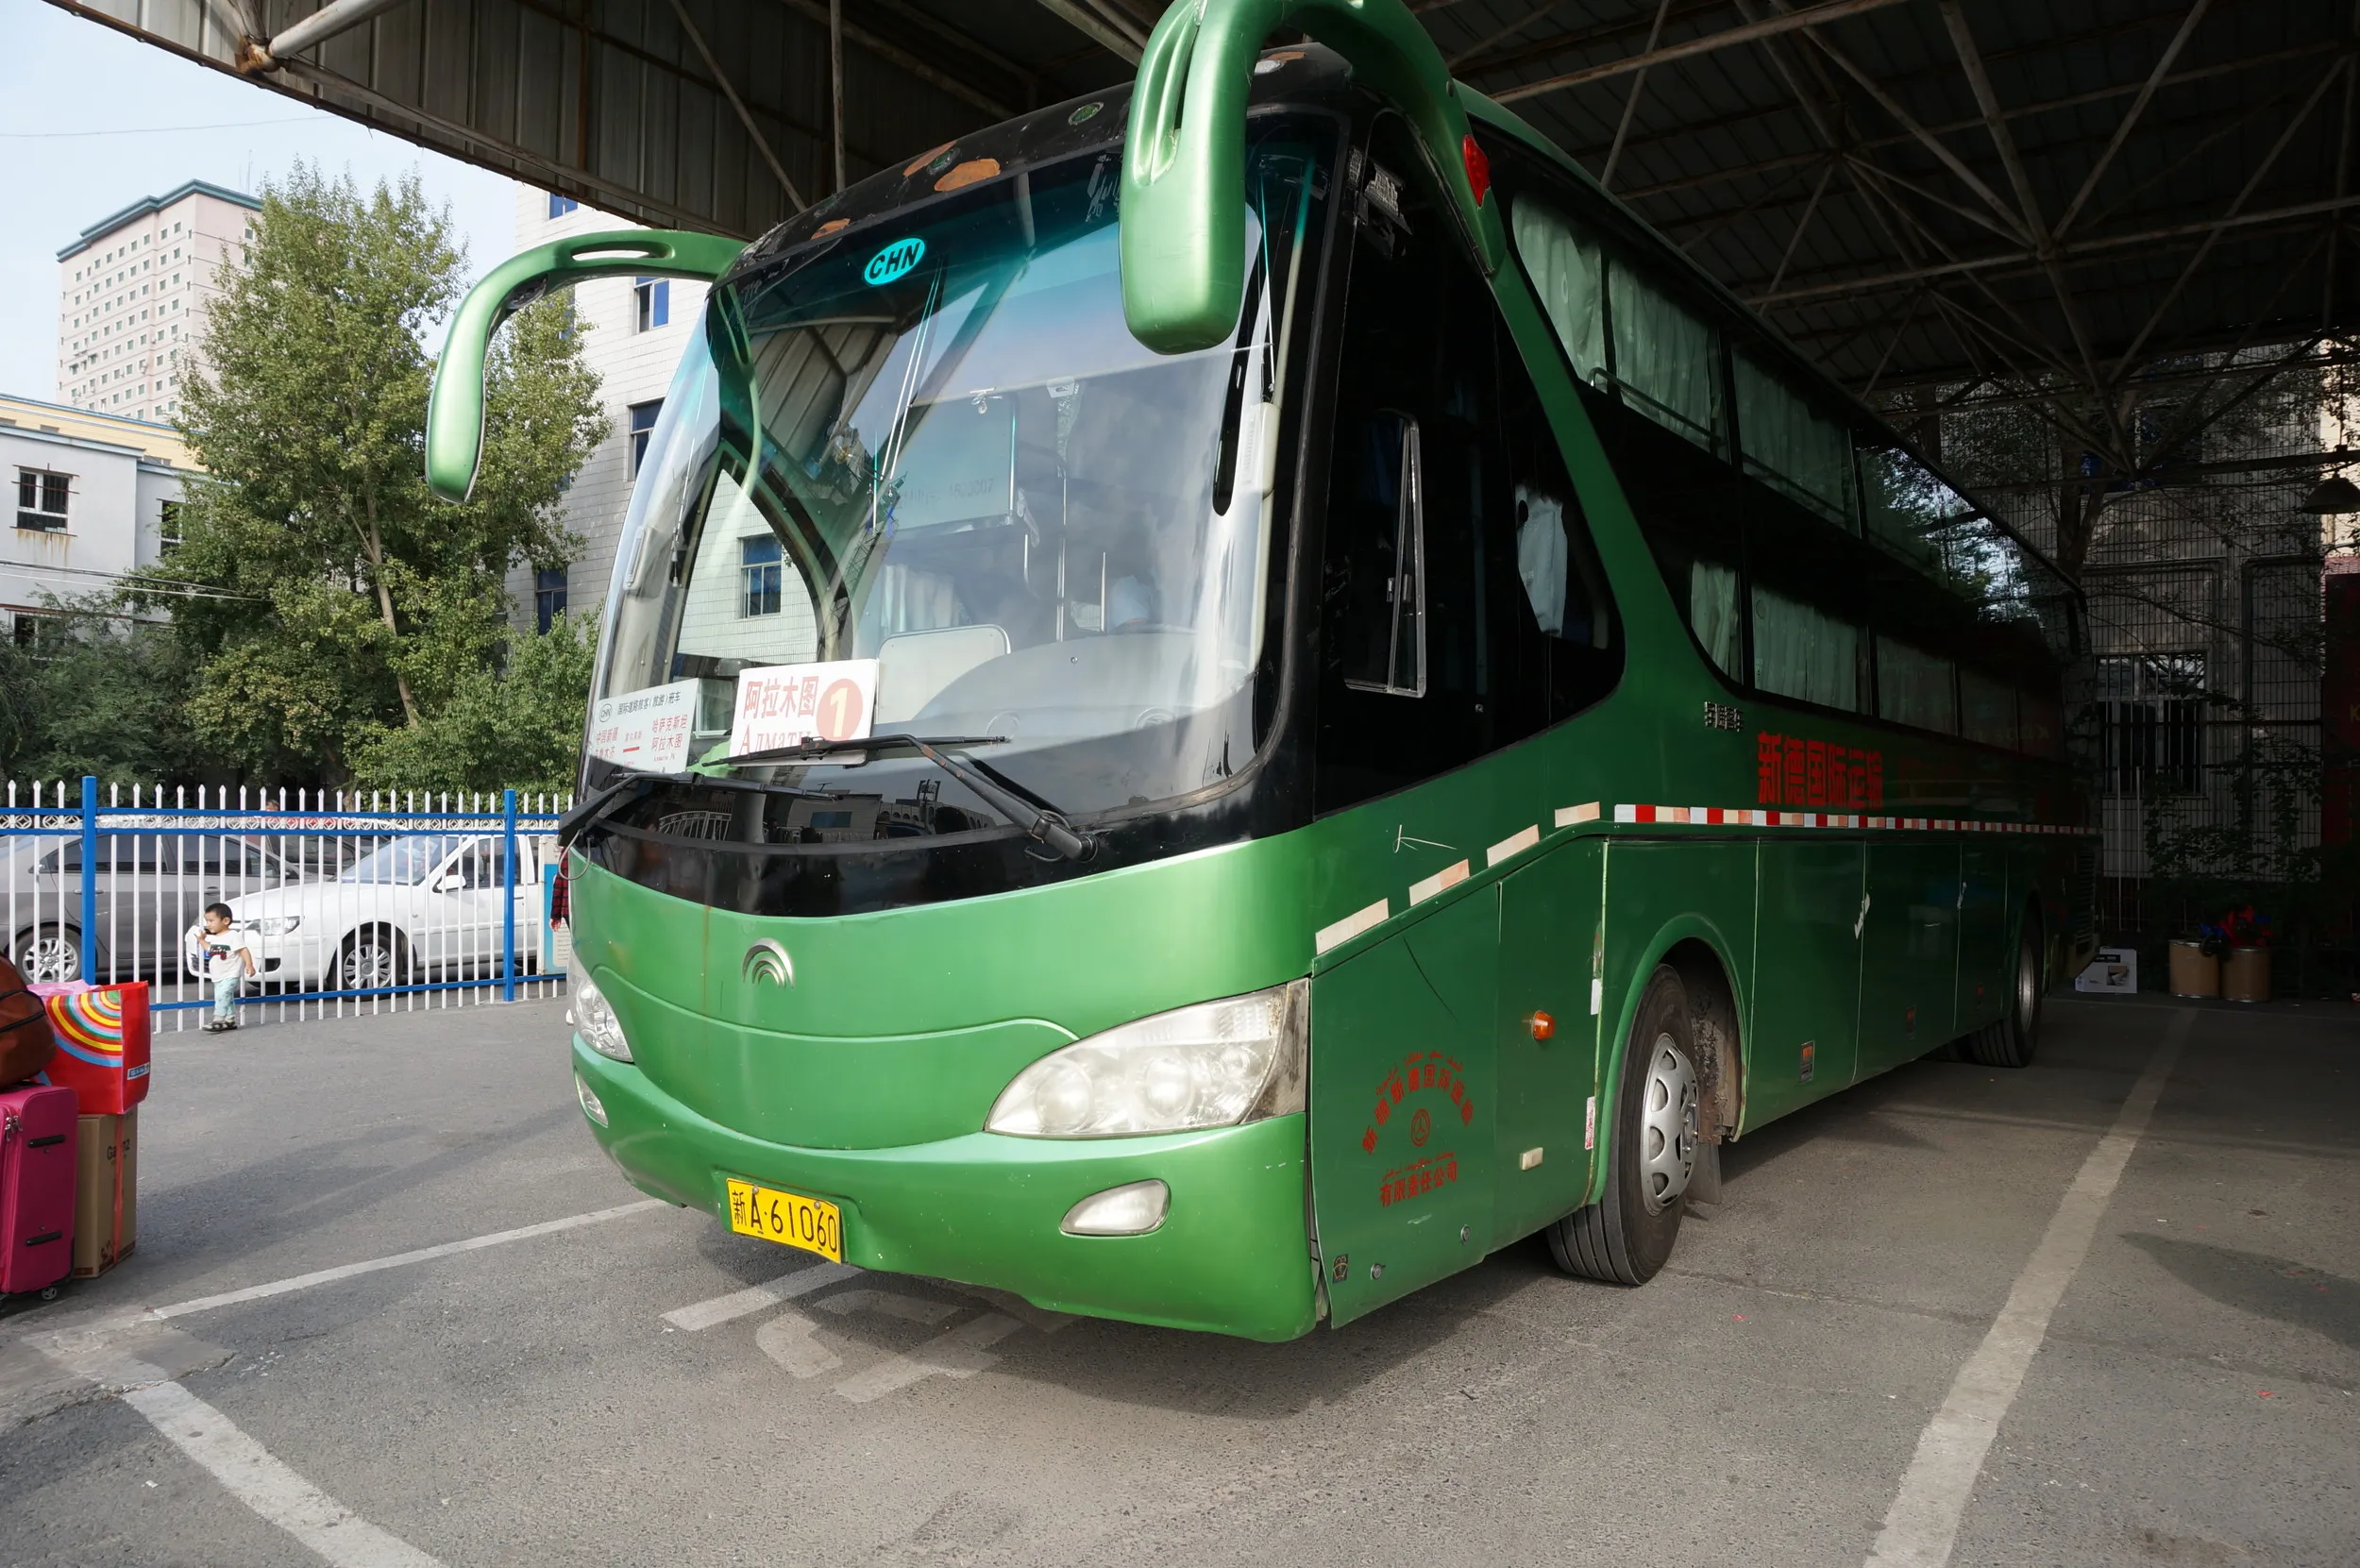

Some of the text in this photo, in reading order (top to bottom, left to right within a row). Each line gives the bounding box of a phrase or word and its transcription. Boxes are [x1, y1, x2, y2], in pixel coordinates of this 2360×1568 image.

[869, 242, 920, 279] CHN
[743, 676, 819, 719] 阿拉木图
[830, 686, 849, 738] 1
[651, 714, 687, 733] 哈萨克斯坦
[651, 733, 683, 751] 阿拉木图
[1758, 730, 1883, 811] 新德国际运输
[1379, 1161, 1458, 1207] 有限责任公司
